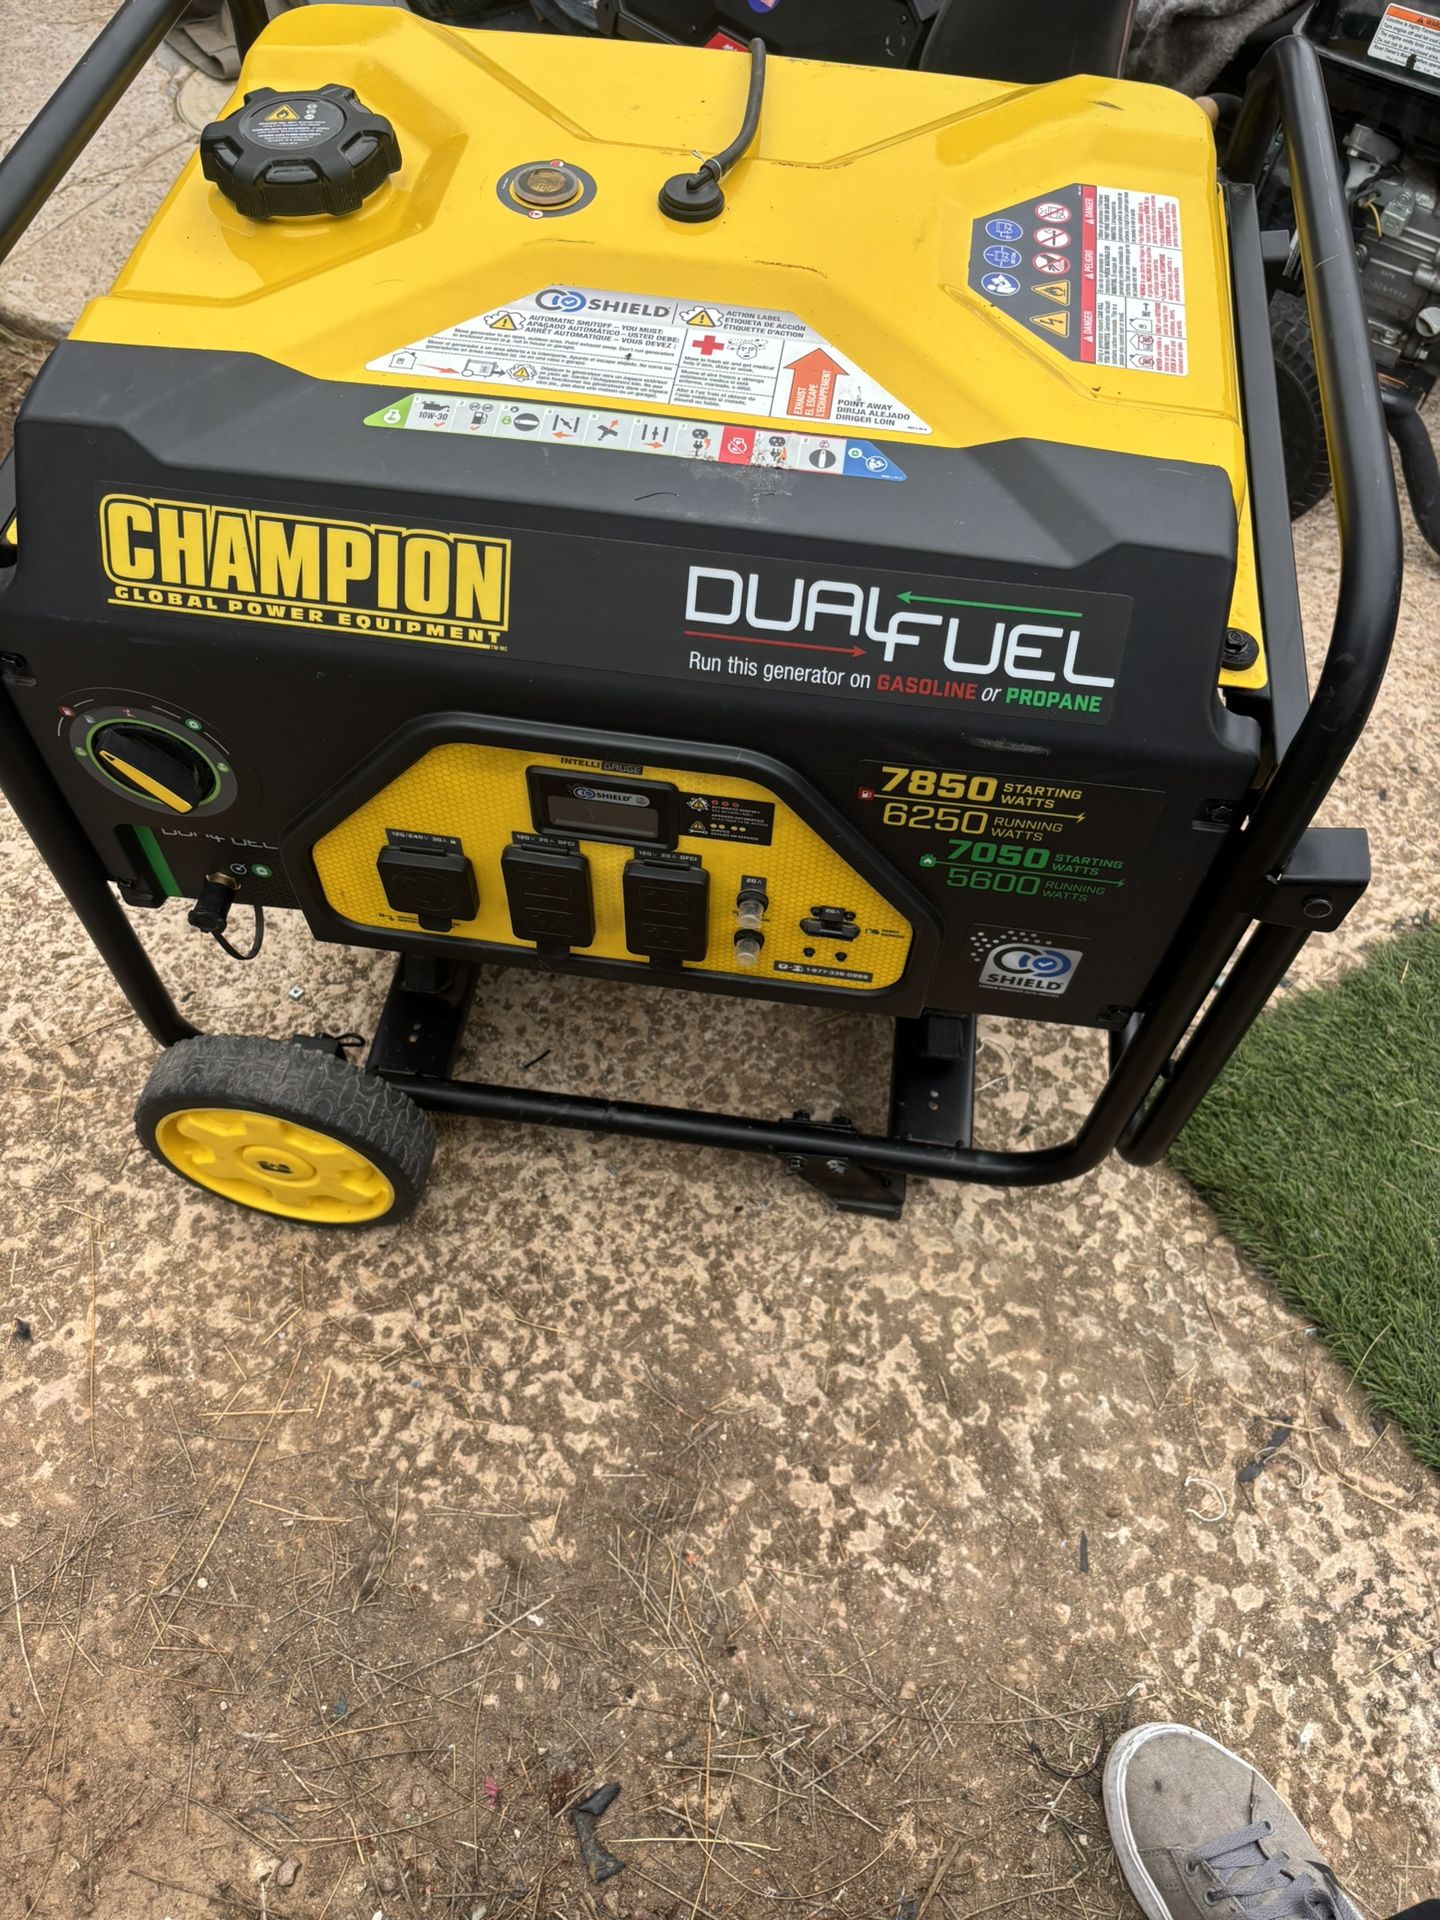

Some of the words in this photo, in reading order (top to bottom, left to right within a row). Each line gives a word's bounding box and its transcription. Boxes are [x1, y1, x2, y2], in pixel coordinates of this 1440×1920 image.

[1085, 197, 1093, 218] DANGER
[1084, 249, 1093, 272] PELIGRO
[588, 299, 670, 317] SHIELD
[726, 310, 755, 318] ACTION
[526, 320, 566, 329] APAGADO
[627, 331, 654, 339] USTED
[528, 314, 575, 324] AUTOMATIC
[576, 320, 612, 328] SHUTOFF
[725, 317, 762, 326] ETIQUETA
[776, 322, 806, 331] ACCIÓN
[1082, 310, 1093, 334] DANGER
[524, 325, 552, 334] ARRÊT
[553, 329, 611, 341] AUTOMATIQUE
[767, 328, 803, 337] D'ACTION
[836, 406, 867, 415] DIRIJA
[868, 409, 910, 420] ALEJADO
[837, 399, 864, 407] POINT
[866, 402, 892, 410] AWAY
[419, 411, 448, 421] 10W-30
[835, 413, 872, 423] DIRIGER
[873, 417, 895, 425] LOIN
[107, 501, 503, 622] CHAMPION
[114, 586, 218, 610] GLOBAL
[229, 599, 323, 624] POWER
[338, 612, 501, 645] EQUIPMENT
[689, 651, 721, 671] Run
[727, 656, 758, 677] this
[763, 659, 846, 687] generator
[850, 673, 871, 689] on
[877, 673, 979, 701] GASOLINE
[982, 686, 1002, 702] or
[1005, 687, 1103, 713] PROPANE
[560, 757, 600, 768] INTELLI
[603, 762, 642, 774] GAUGE
[881, 766, 998, 803] 7850
[1003, 782, 1083, 800] STARTING
[597, 792, 630, 802] SHIELD
[1001, 794, 1055, 809] WATTS
[883, 802, 988, 835] 6250
[993, 816, 1064, 833] RUNNING
[990, 827, 1043, 842] WATTS
[947, 839, 1051, 869] 7050
[1054, 853, 1124, 870] STARTING
[1051, 863, 1101, 876] WATTS
[946, 868, 1041, 896] 5600
[1045, 880, 1106, 896] RUNNING
[1042, 889, 1088, 902] WATTS
[986, 973, 1062, 991] SHIELD
